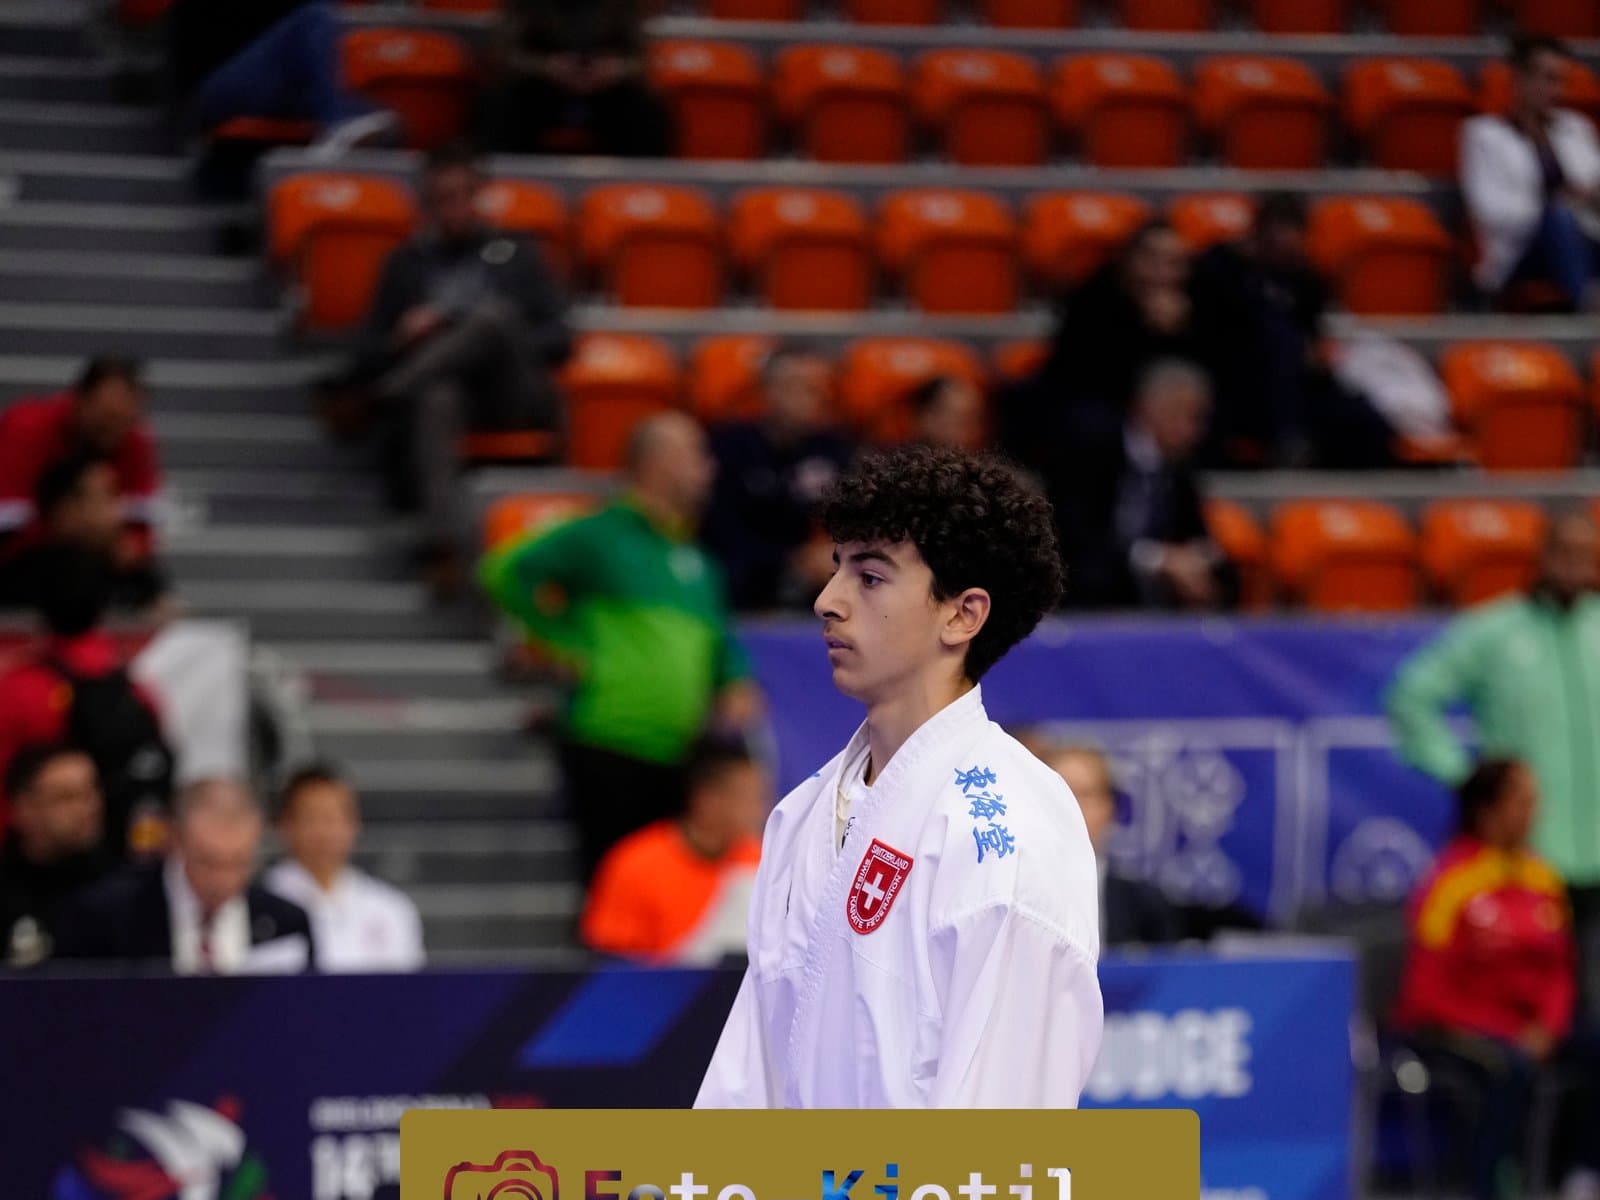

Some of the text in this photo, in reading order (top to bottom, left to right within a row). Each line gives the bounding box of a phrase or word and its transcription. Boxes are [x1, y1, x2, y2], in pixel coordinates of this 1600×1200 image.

[871, 844, 909, 871] SWITZERLAND
[850, 858, 902, 929] SWISS KARATE FEDERATION
